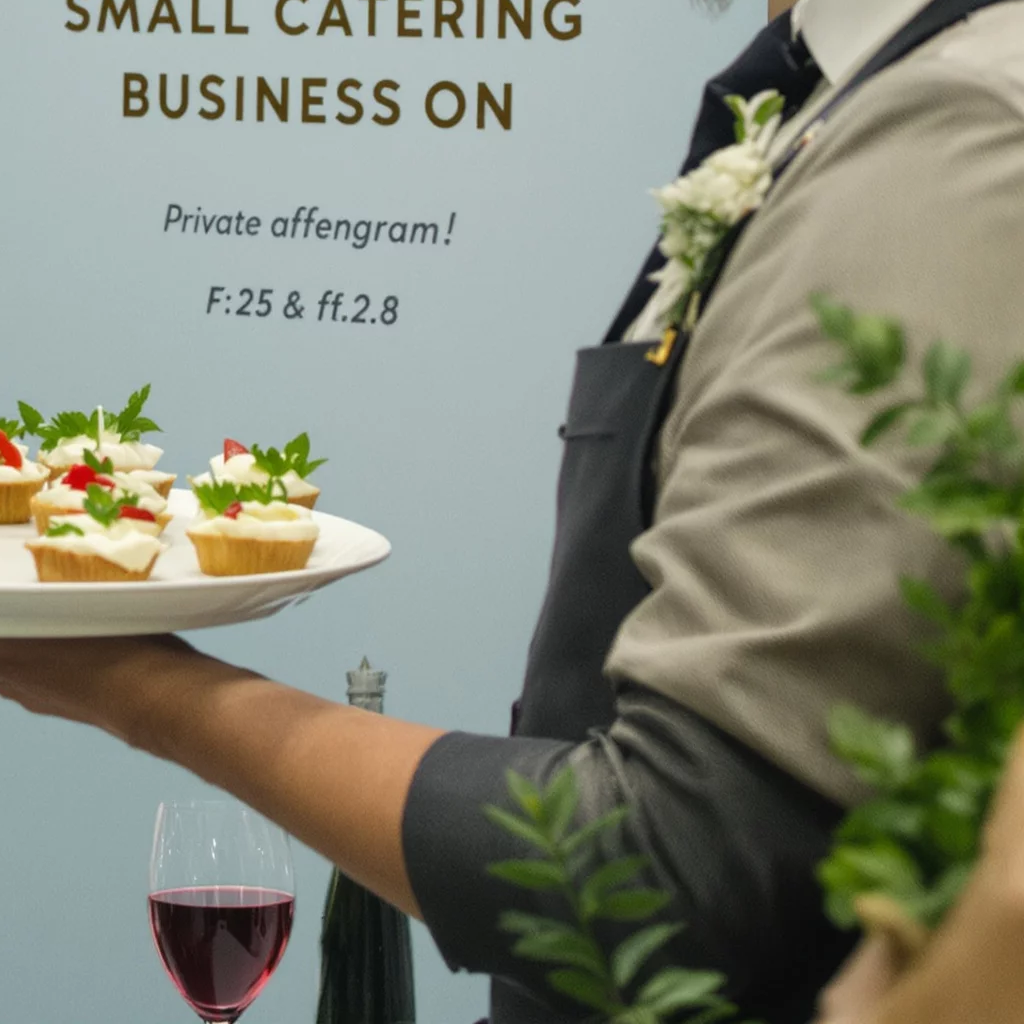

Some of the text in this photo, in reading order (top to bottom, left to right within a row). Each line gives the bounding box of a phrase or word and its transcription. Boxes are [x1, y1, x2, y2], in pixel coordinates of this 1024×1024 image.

[122, 71, 513, 132] BUSINESS ON
[163, 203, 457, 250] Private affengram!
[205, 285, 400, 327] F:25 & ff.2.8
